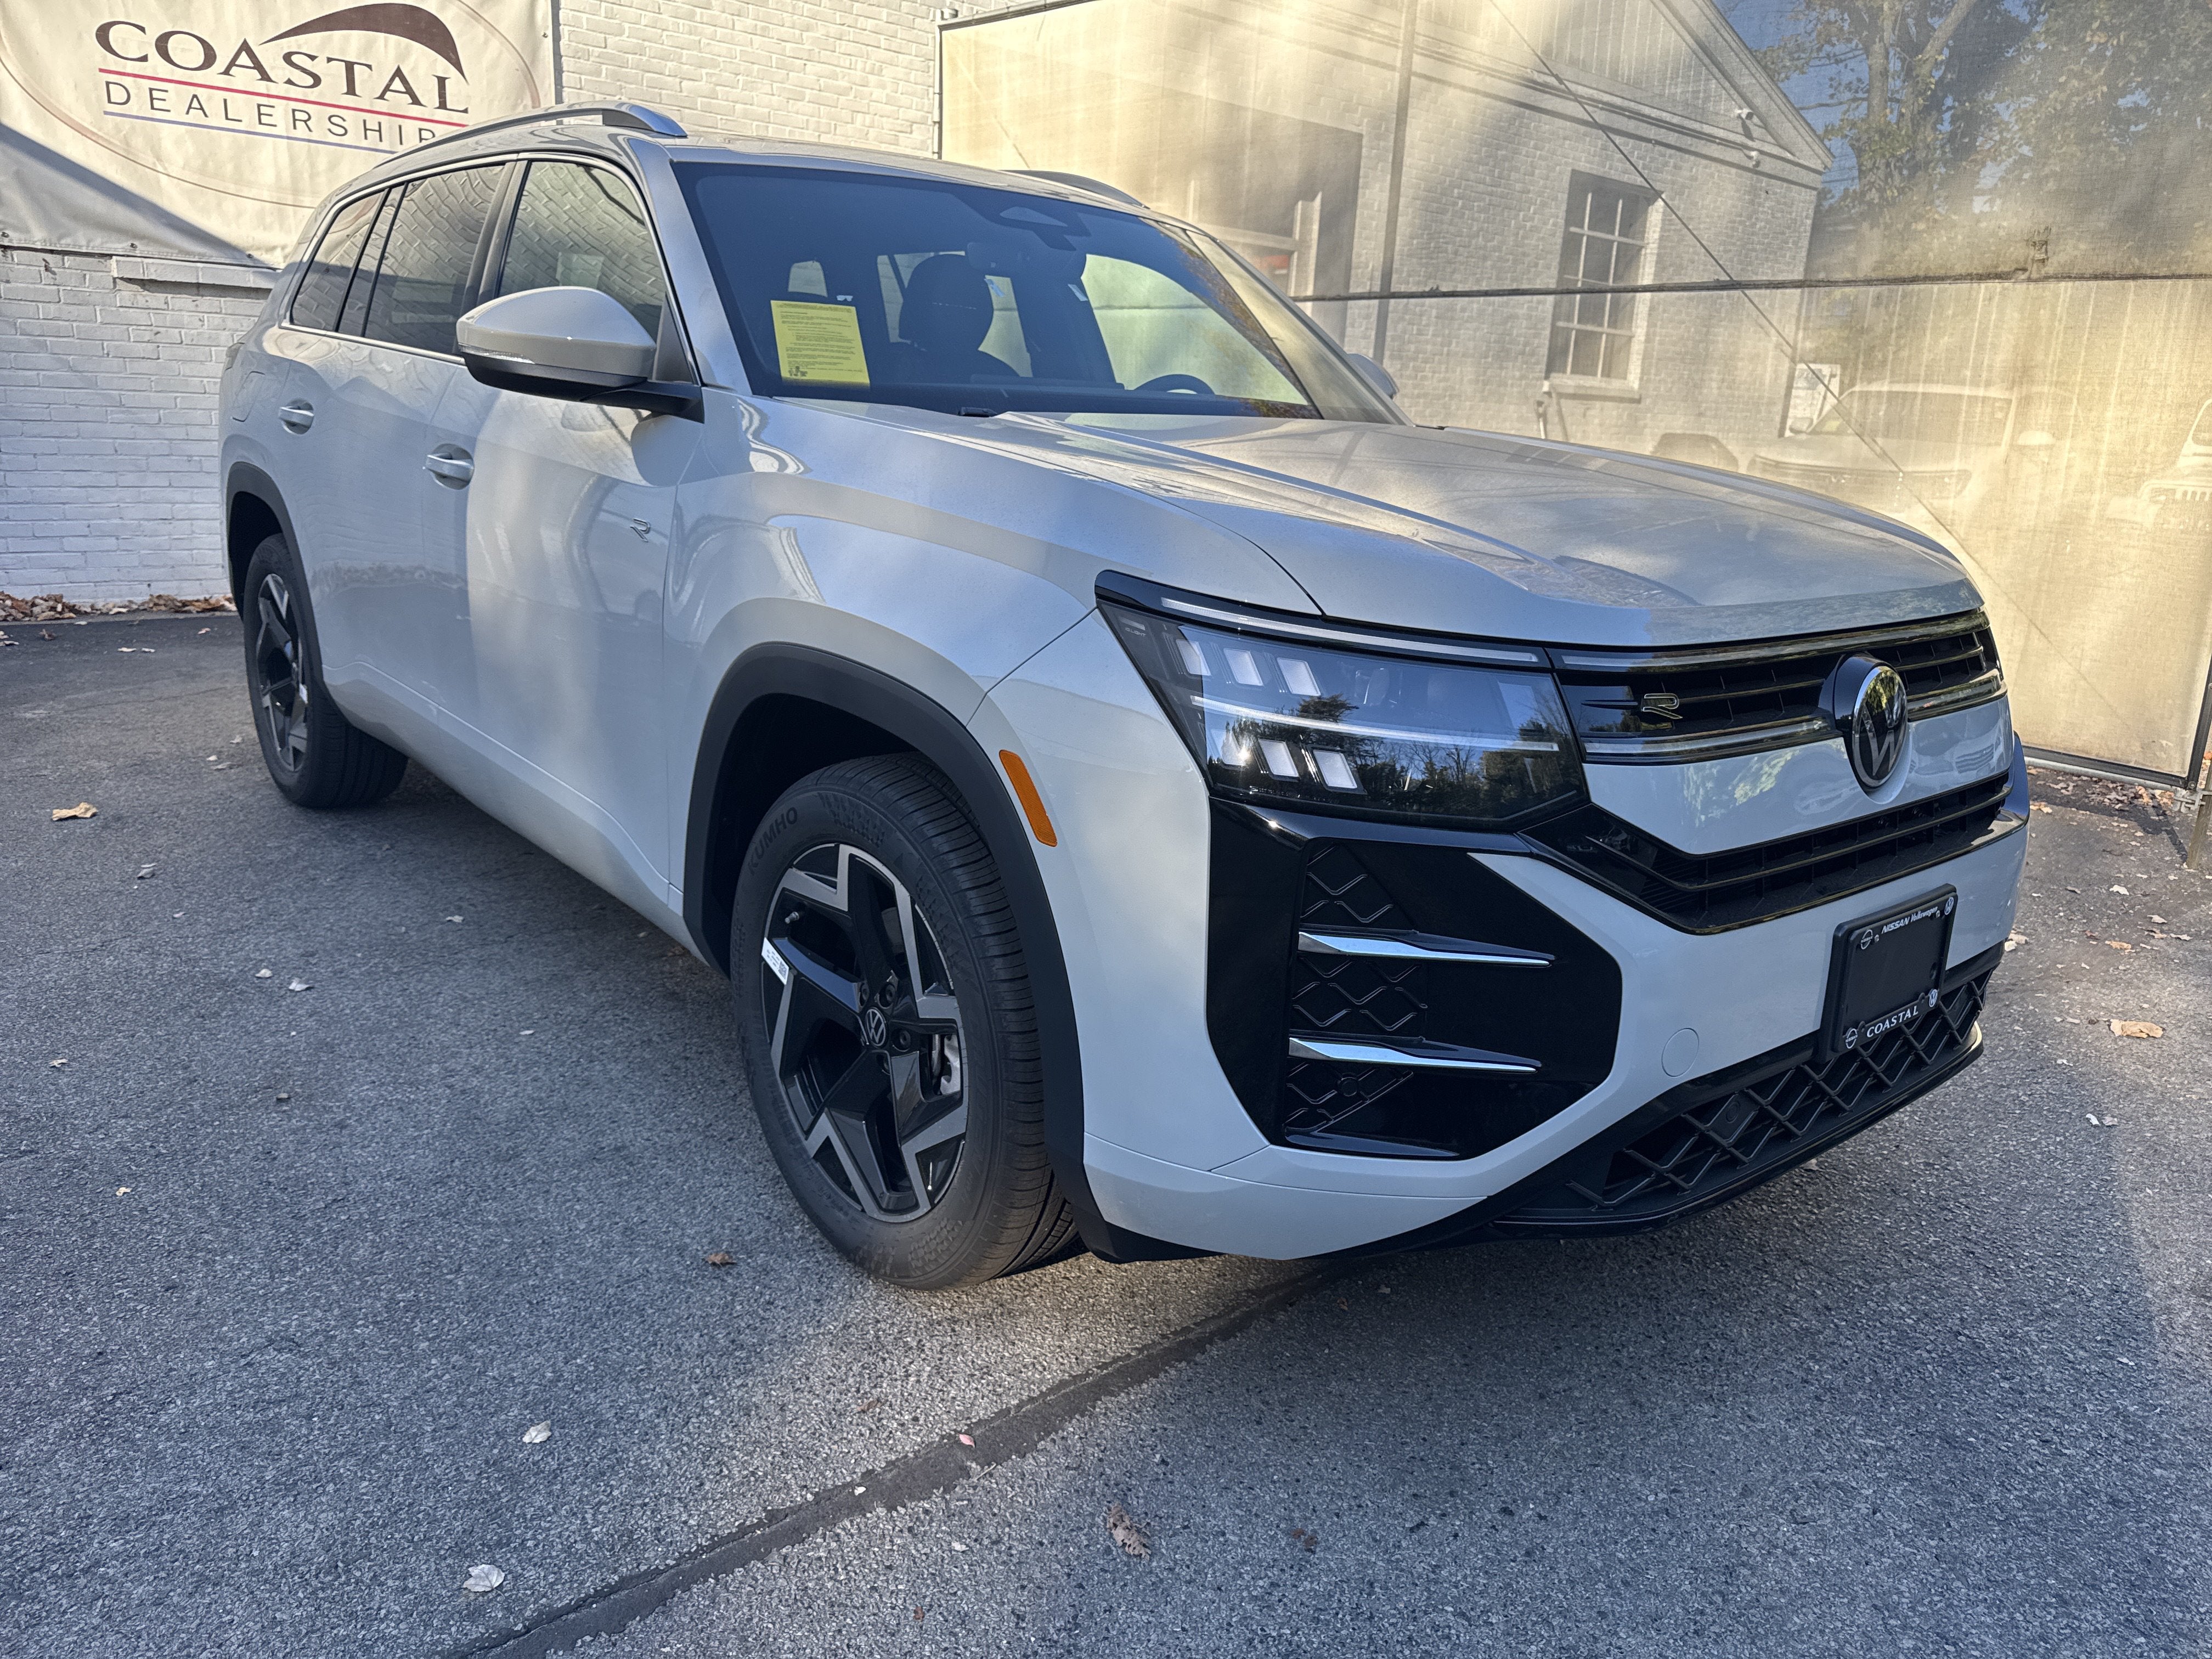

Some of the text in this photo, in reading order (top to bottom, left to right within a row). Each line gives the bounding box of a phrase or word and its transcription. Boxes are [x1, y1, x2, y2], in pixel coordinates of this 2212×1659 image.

[94, 20, 469, 114] COASTAL
[747, 806, 798, 876] KUMHO
[1881, 917, 1910, 934] NISSAN
[1866, 1005, 1918, 1037] COASTAL
